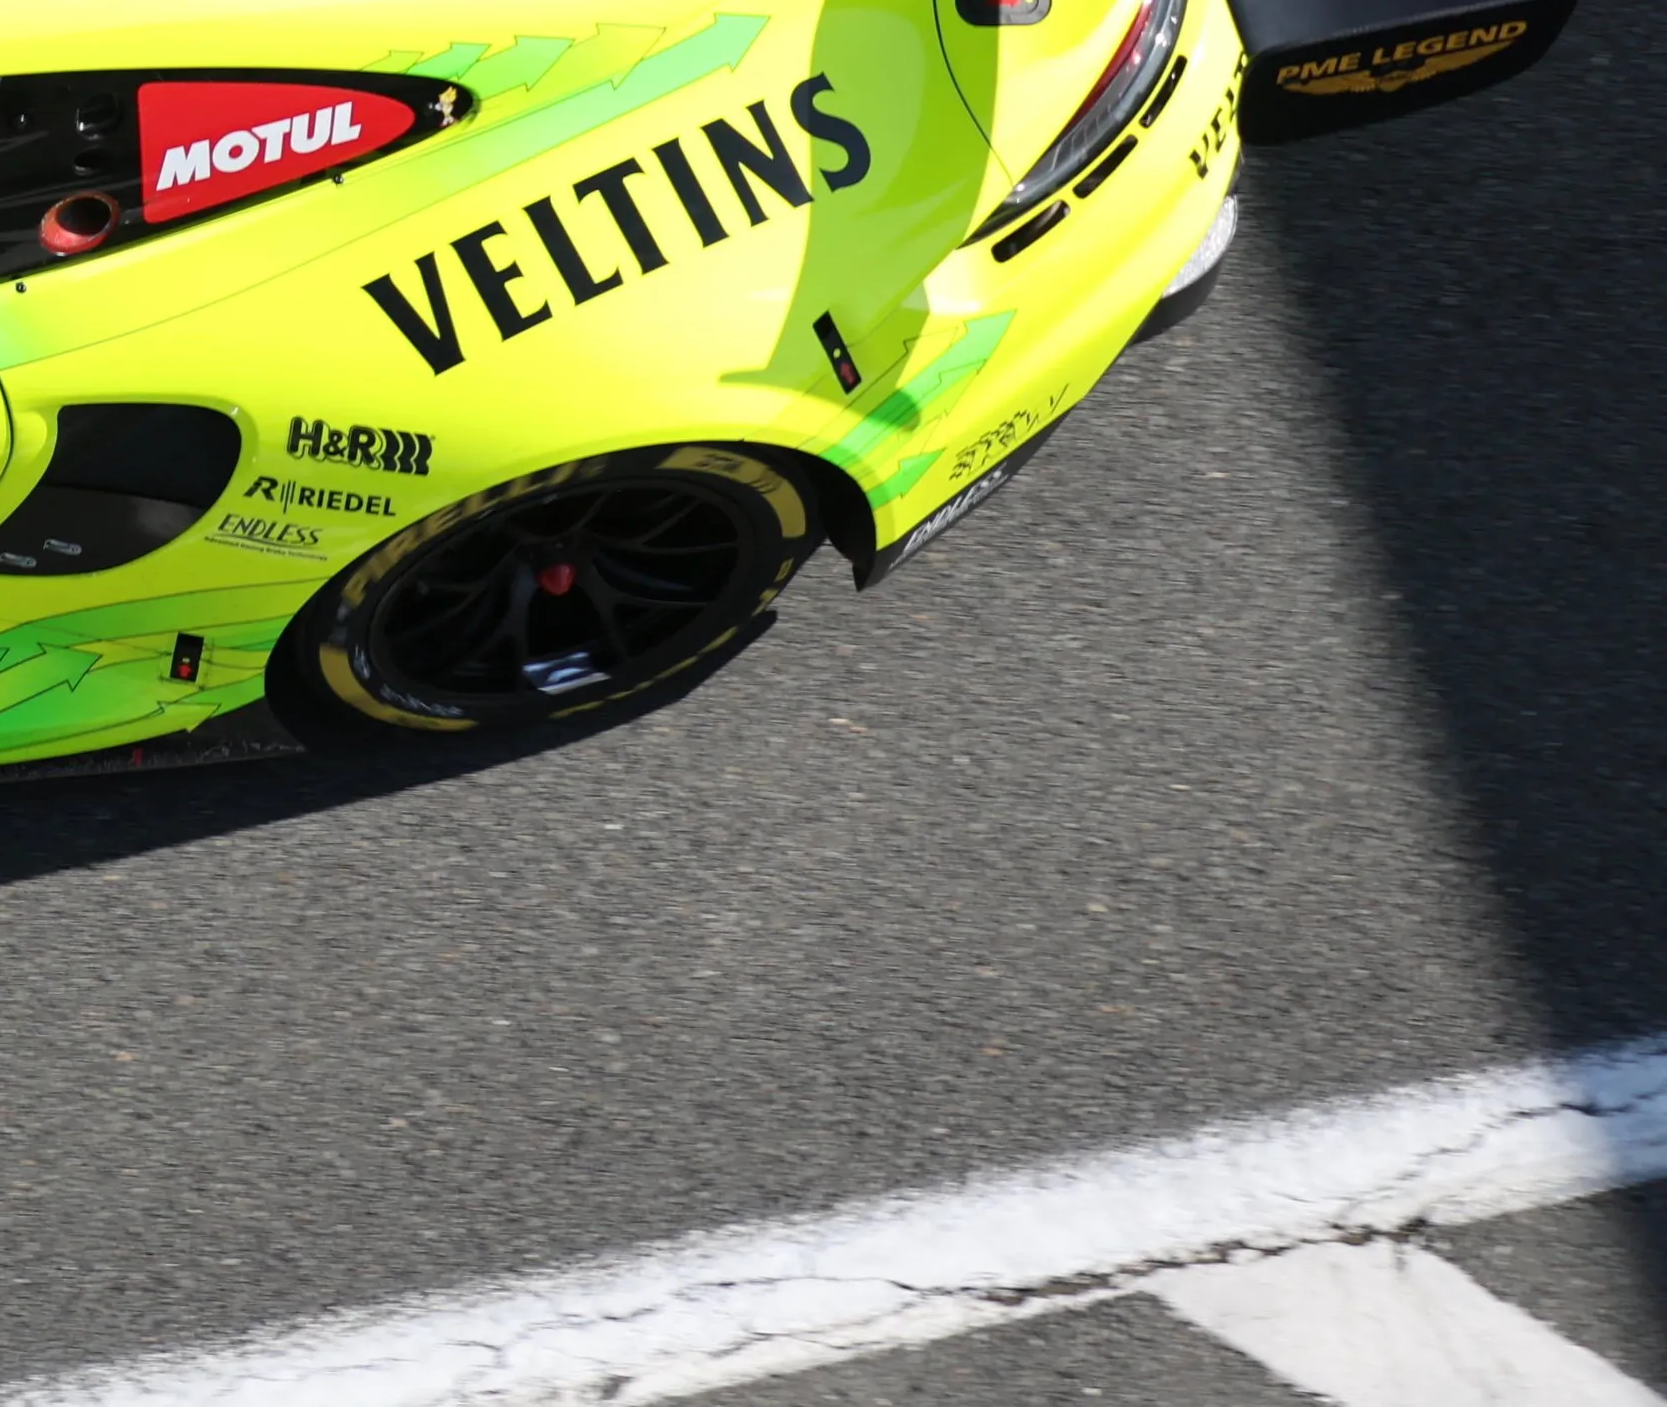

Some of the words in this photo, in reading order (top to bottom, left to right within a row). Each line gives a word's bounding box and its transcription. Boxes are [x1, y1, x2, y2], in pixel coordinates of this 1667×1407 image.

[1276, 51, 1361, 85] PME
[1372, 20, 1528, 66] LEGEND
[155, 101, 363, 191] MOTUL
[362, 73, 872, 377] VELTINS
[287, 416, 385, 471] H&R
[218, 513, 323, 545] ENDLESS
[298, 486, 397, 517] RIEDEL
